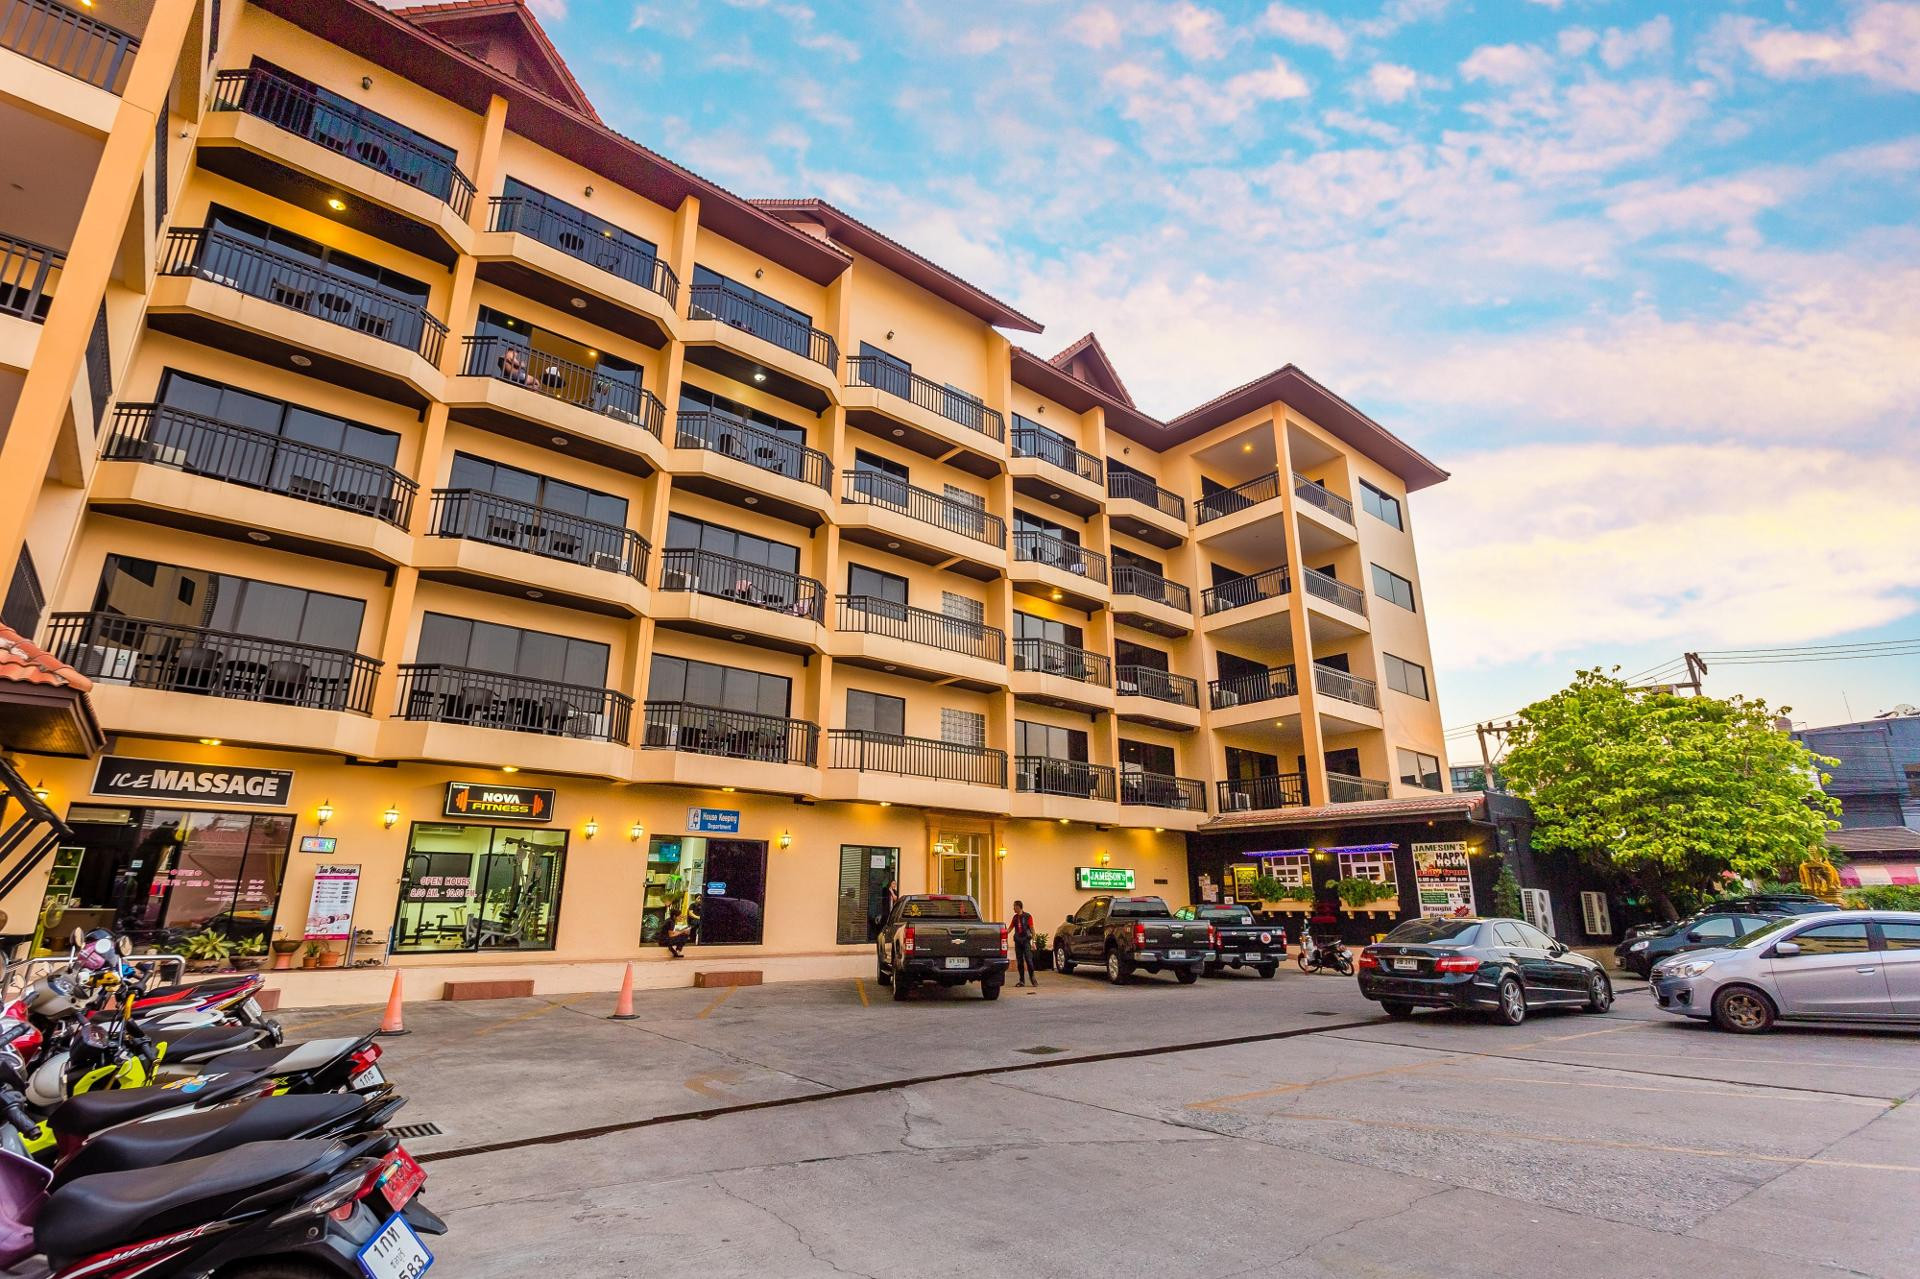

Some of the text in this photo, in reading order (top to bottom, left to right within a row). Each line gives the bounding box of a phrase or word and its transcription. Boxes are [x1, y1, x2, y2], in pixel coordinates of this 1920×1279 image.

[109, 769, 280, 797] ICE MASSAGE
[482, 792, 520, 804] NOVA
[472, 803, 529, 813] FITNESS
[703, 812, 737, 824] House Keeping
[707, 822, 732, 830] Department
[1414, 844, 1466, 852] JAMESON'S
[1436, 859, 1467, 867] HOUR
[420, 876, 443, 885] OPEN
[1090, 871, 1126, 881] JAMESON'S
